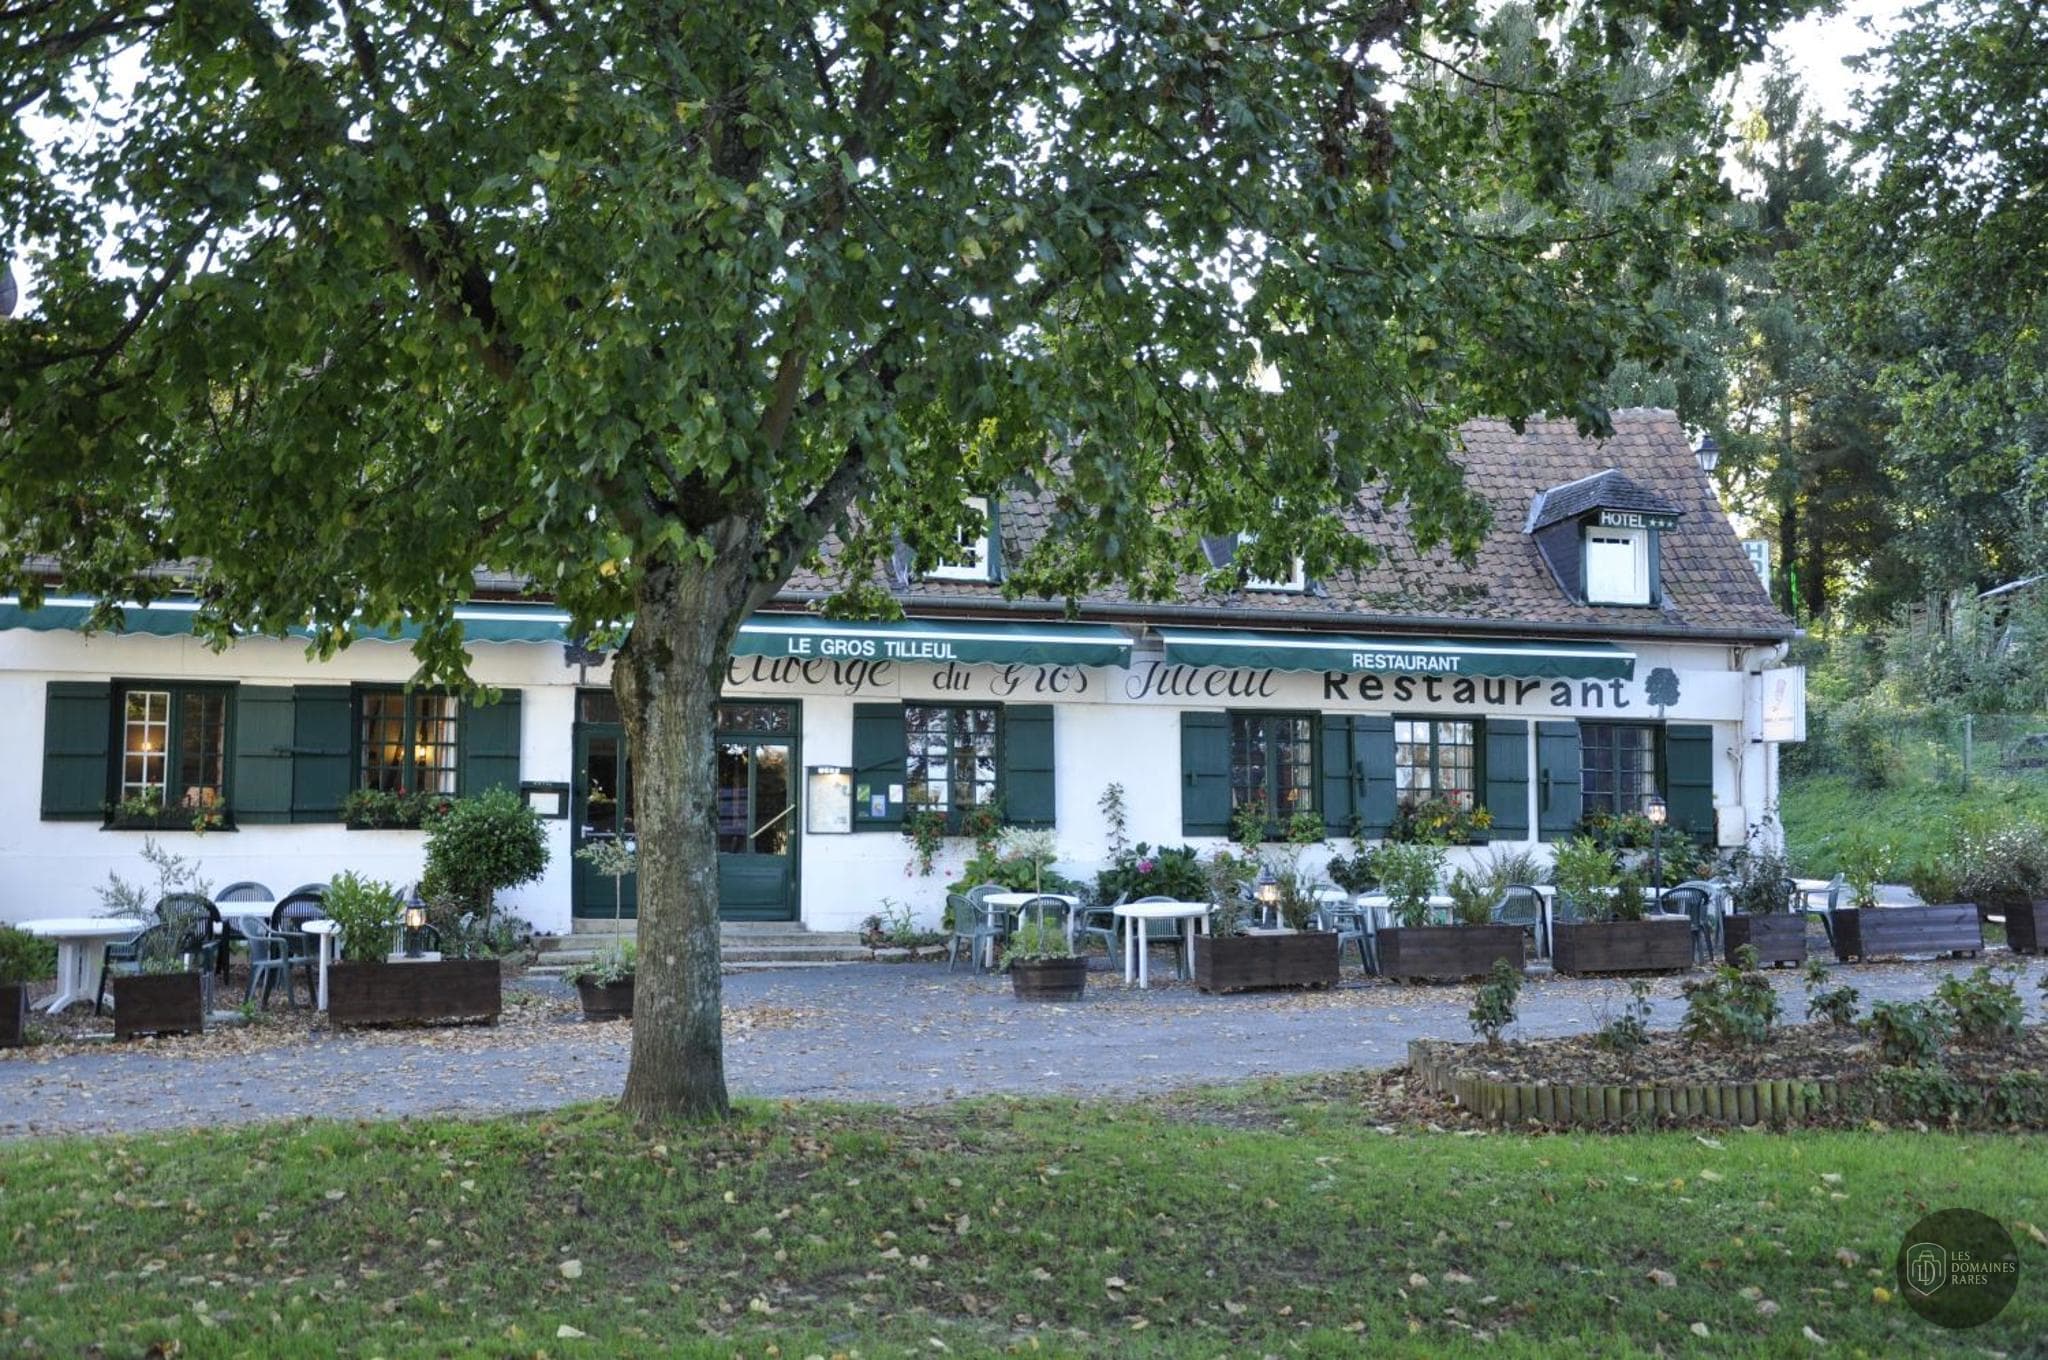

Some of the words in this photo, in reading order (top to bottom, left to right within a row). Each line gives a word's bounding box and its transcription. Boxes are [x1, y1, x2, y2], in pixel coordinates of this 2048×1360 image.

[1601, 511, 1646, 528] HOTEL
[788, 637, 811, 654] LE
[820, 639, 875, 657] GROS
[884, 641, 957, 660] TILLEUL
[1352, 653, 1461, 672] RESTAURANT
[932, 662, 971, 691] du
[1323, 671, 1630, 709] Restaurant
